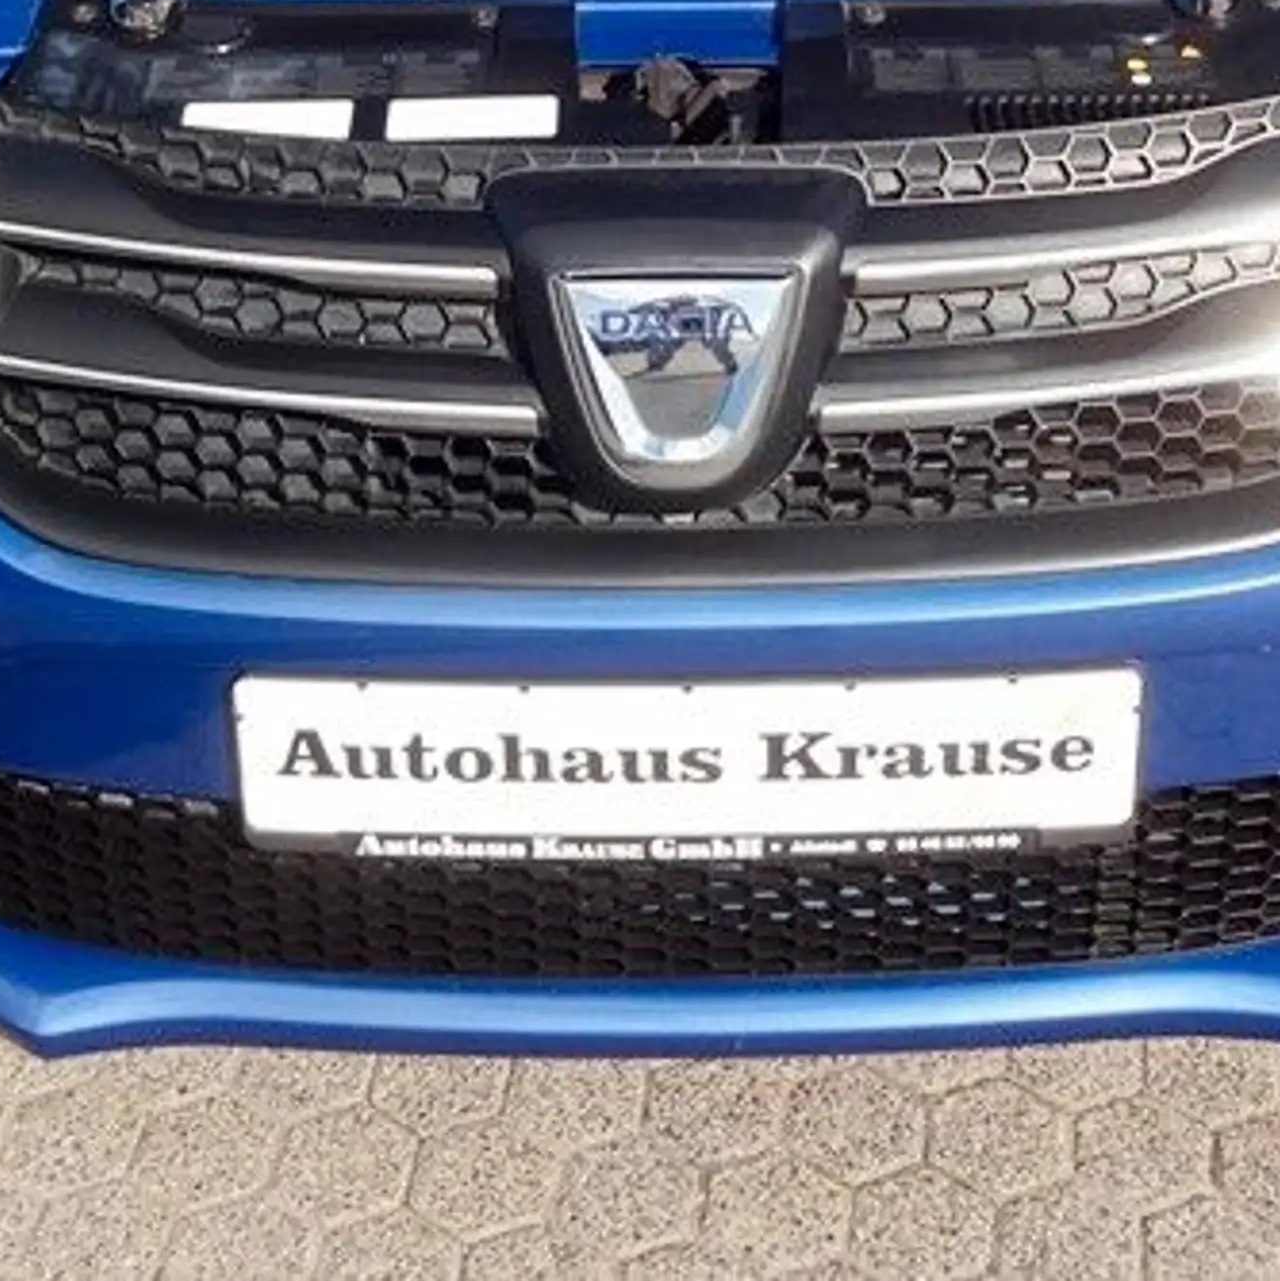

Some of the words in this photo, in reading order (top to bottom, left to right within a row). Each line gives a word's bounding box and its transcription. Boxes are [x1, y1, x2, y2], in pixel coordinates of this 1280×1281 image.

[600, 308, 750, 341] DACIA
[276, 728, 723, 784] Autohaus
[758, 731, 1096, 781] Krause
[356, 833, 527, 858] Autohaus
[648, 836, 764, 860] GmbH
